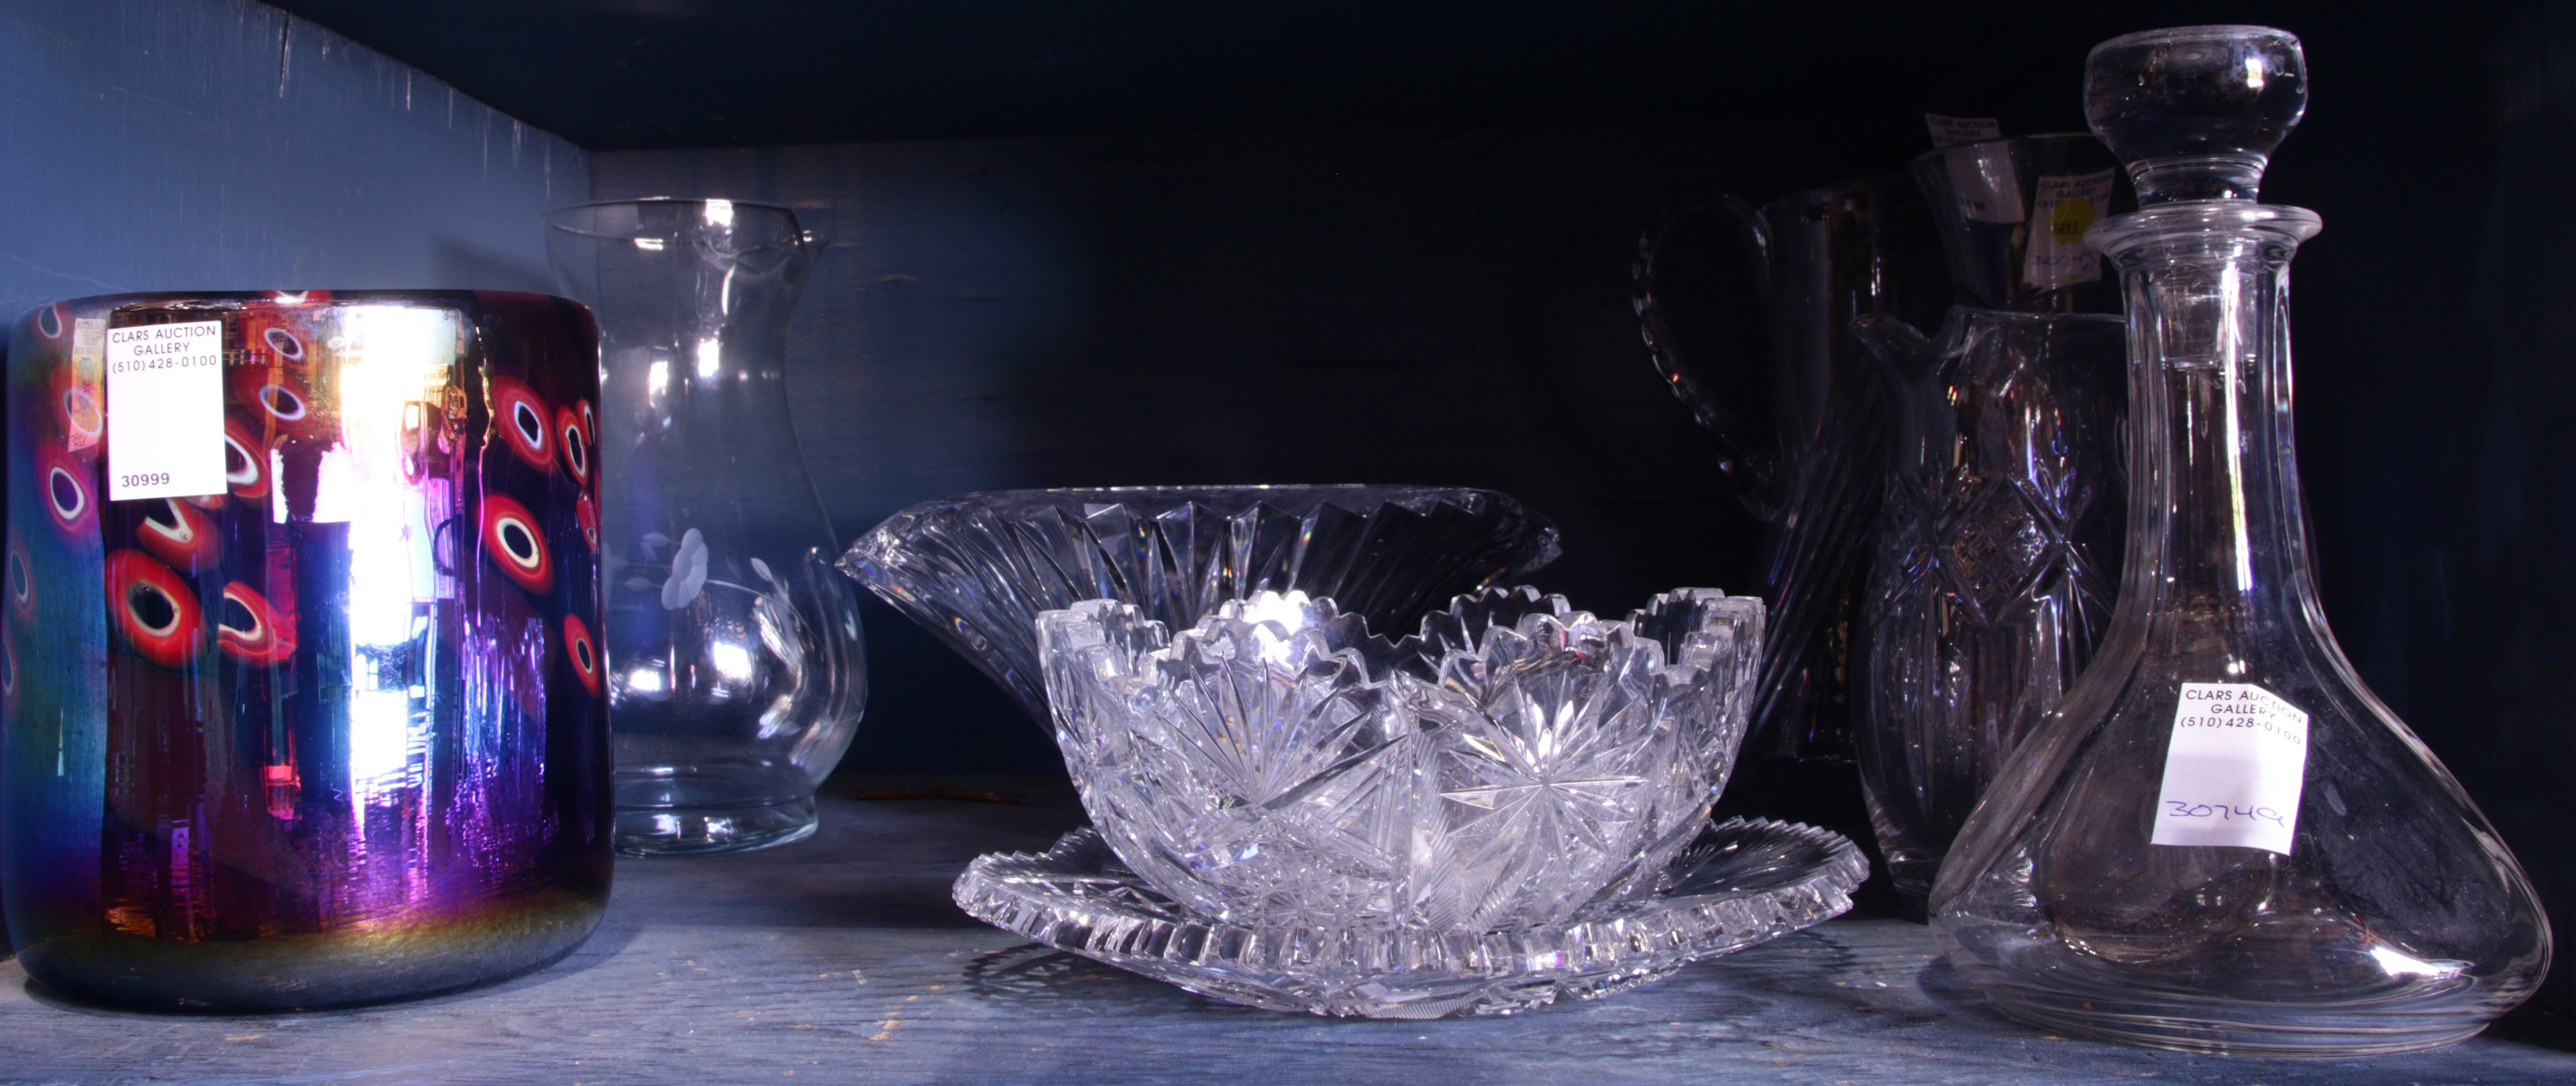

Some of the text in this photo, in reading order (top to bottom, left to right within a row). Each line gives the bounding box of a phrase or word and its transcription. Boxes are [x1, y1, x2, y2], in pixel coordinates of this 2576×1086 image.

[1929, 117, 1996, 129] CLARS AUCTION
[1945, 127, 1981, 138] GALLERY
[2041, 173, 2112, 188] CLARS AUCTION
[2056, 186, 2097, 199] GALLERY
[112, 329, 149, 343] CLARS
[155, 325, 216, 339] AUCTION
[133, 341, 190, 356] GALLERY
[112, 355, 217, 374] (510)428-0100
[121, 472, 170, 488] 30999
[2186, 690, 2302, 724] CLARS AUCTION
[2211, 704, 2276, 720] GALLERY
[2180, 716, 2301, 745] (510)428-0100
